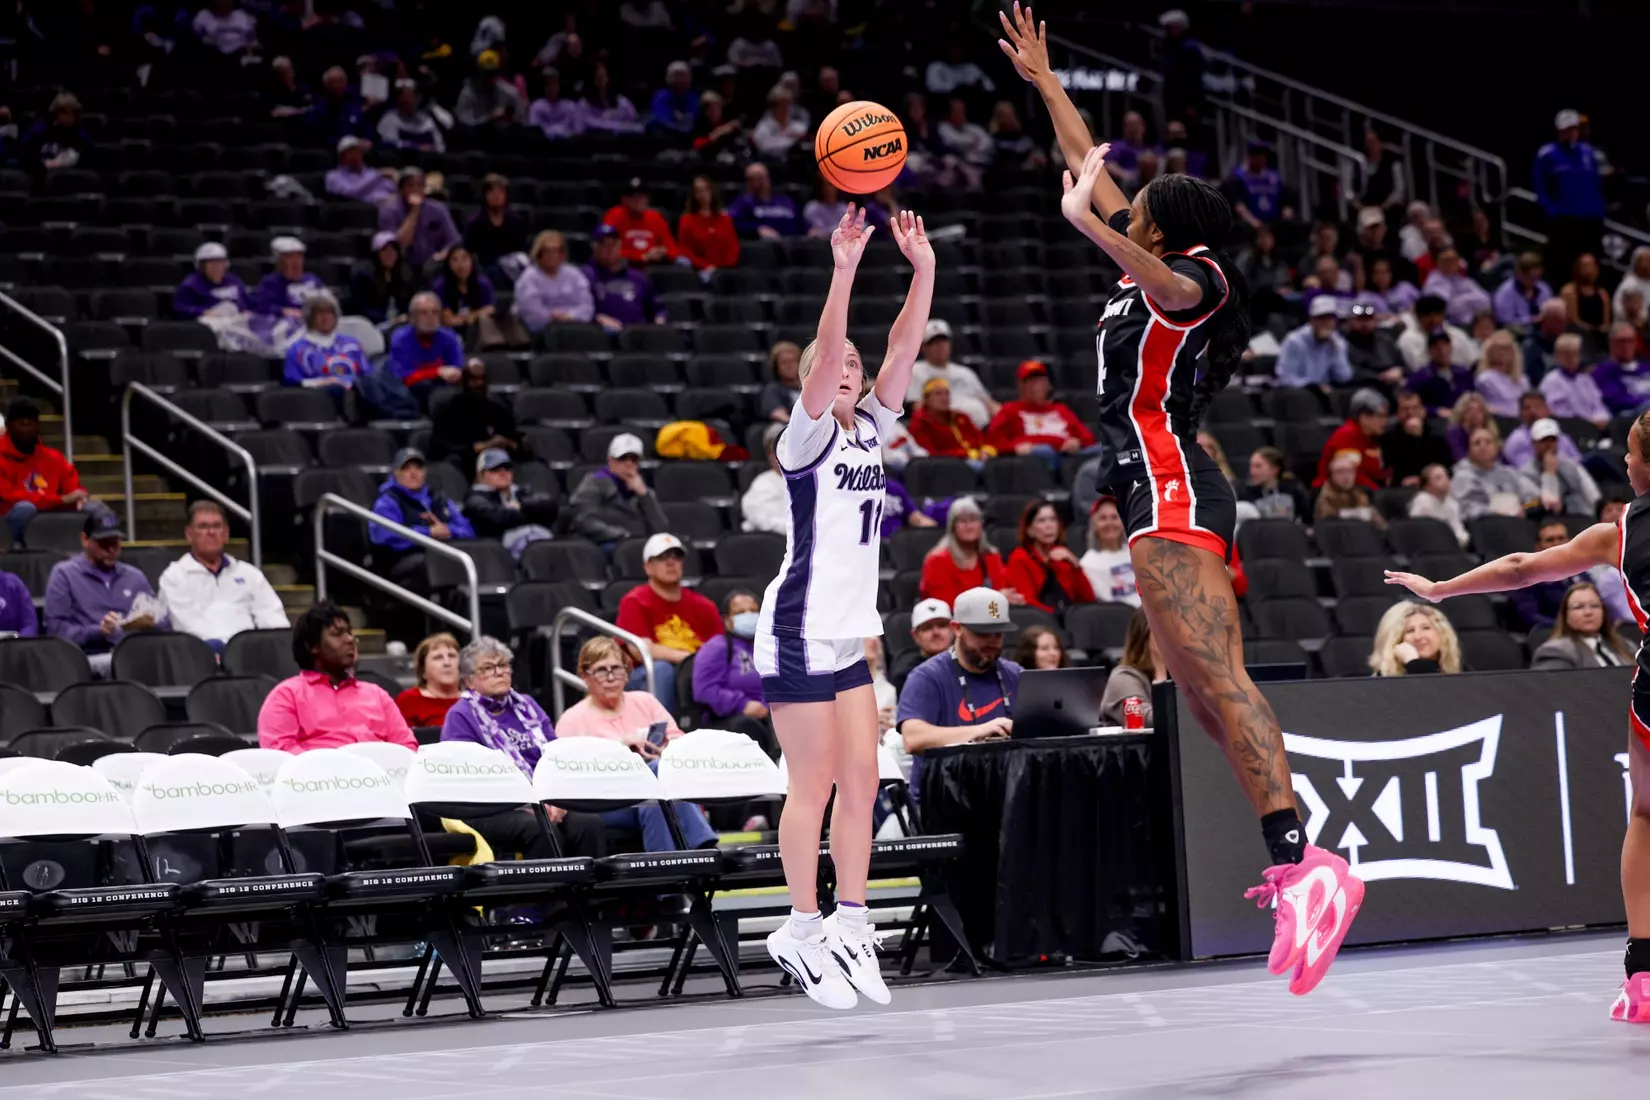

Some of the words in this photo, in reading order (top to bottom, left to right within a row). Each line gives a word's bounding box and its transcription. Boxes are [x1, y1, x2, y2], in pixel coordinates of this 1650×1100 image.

[842, 113, 897, 136] Wilson
[863, 138, 902, 161] NCAA
[834, 462, 886, 491] Wild
[151, 781, 259, 800] bambooHR
[5, 789, 120, 805] bambooHR
[906, 841, 958, 850] CONFERENCE
[660, 857, 715, 866] CONFERENCE
[529, 864, 585, 873] CONFERENCE
[395, 873, 454, 883] CONFERENCE
[252, 880, 314, 891] CONFERENCE
[106, 891, 169, 902] CONFERENCE
